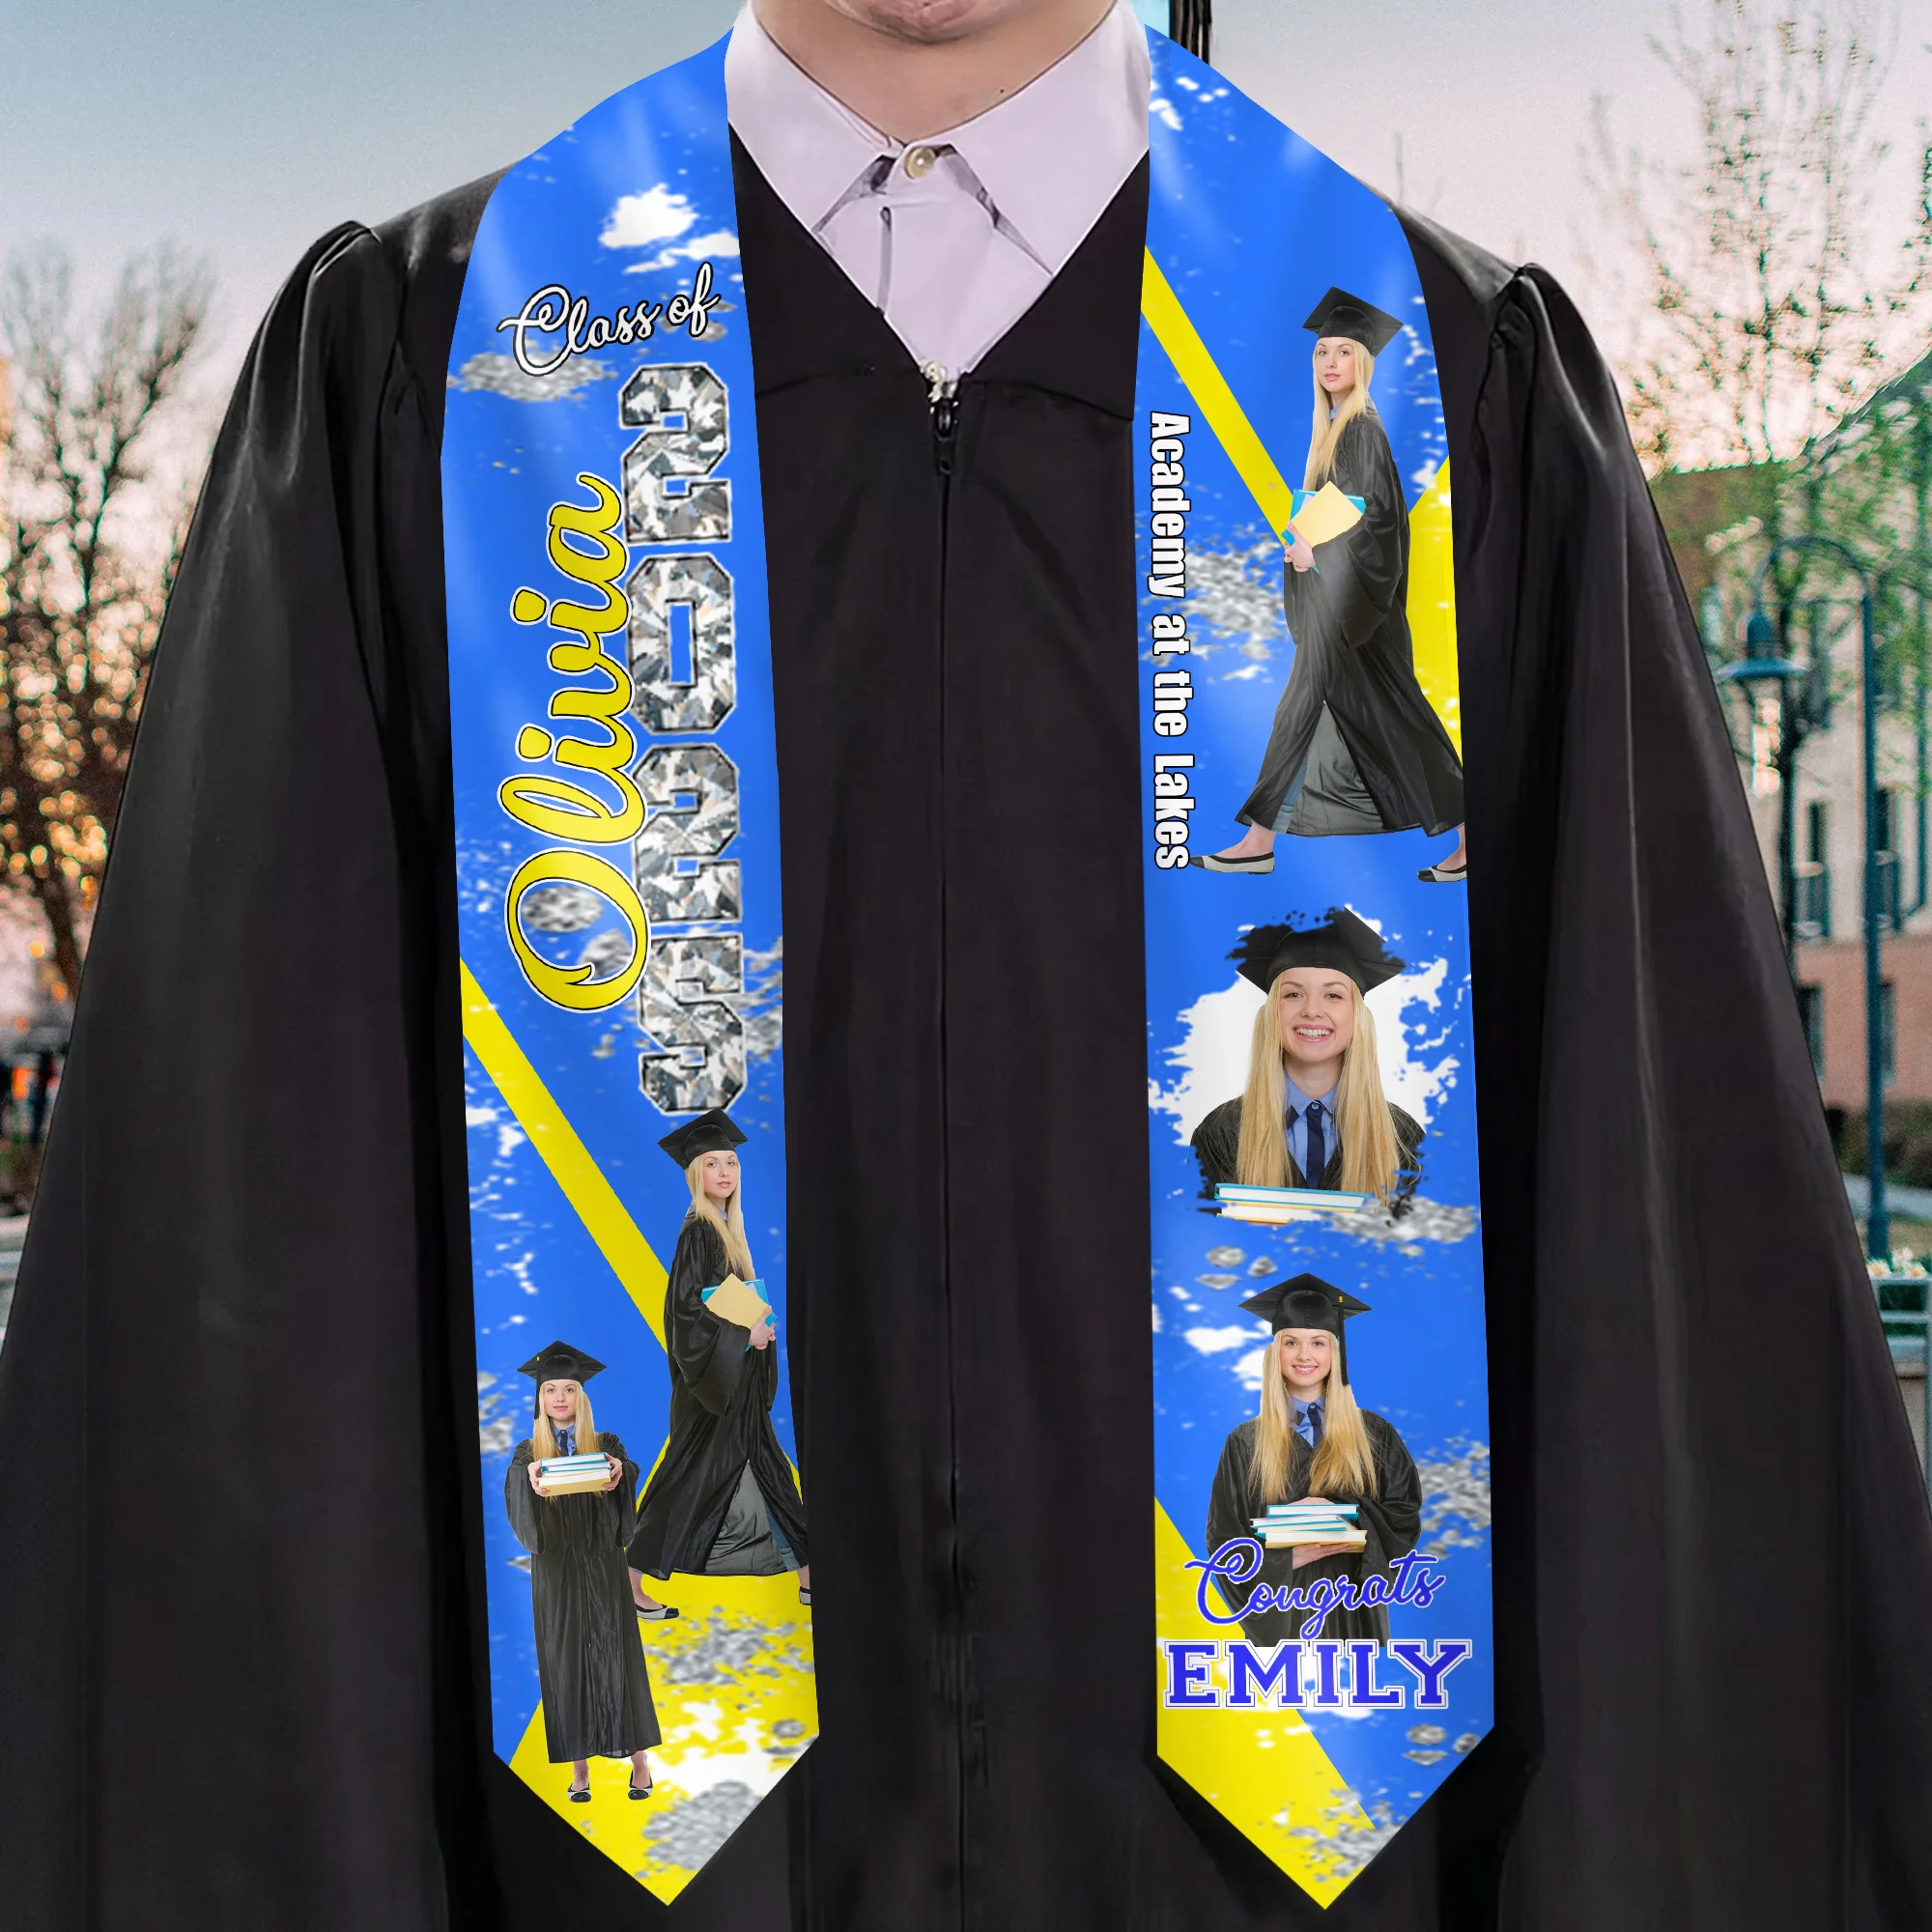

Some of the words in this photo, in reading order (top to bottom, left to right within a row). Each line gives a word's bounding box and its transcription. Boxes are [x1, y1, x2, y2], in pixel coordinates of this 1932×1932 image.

[497, 285, 662, 377] Class
[668, 262, 721, 335] of
[1148, 412, 1192, 599] Academy
[1151, 613, 1191, 656] at
[497, 471, 651, 1012] Olivia
[618, 362, 748, 1115] 2025
[1152, 669, 1194, 737] the
[1153, 753, 1196, 869] Lakes
[1183, 1537, 1446, 1640] Congrats
[1163, 1639, 1473, 1709] EMILY
